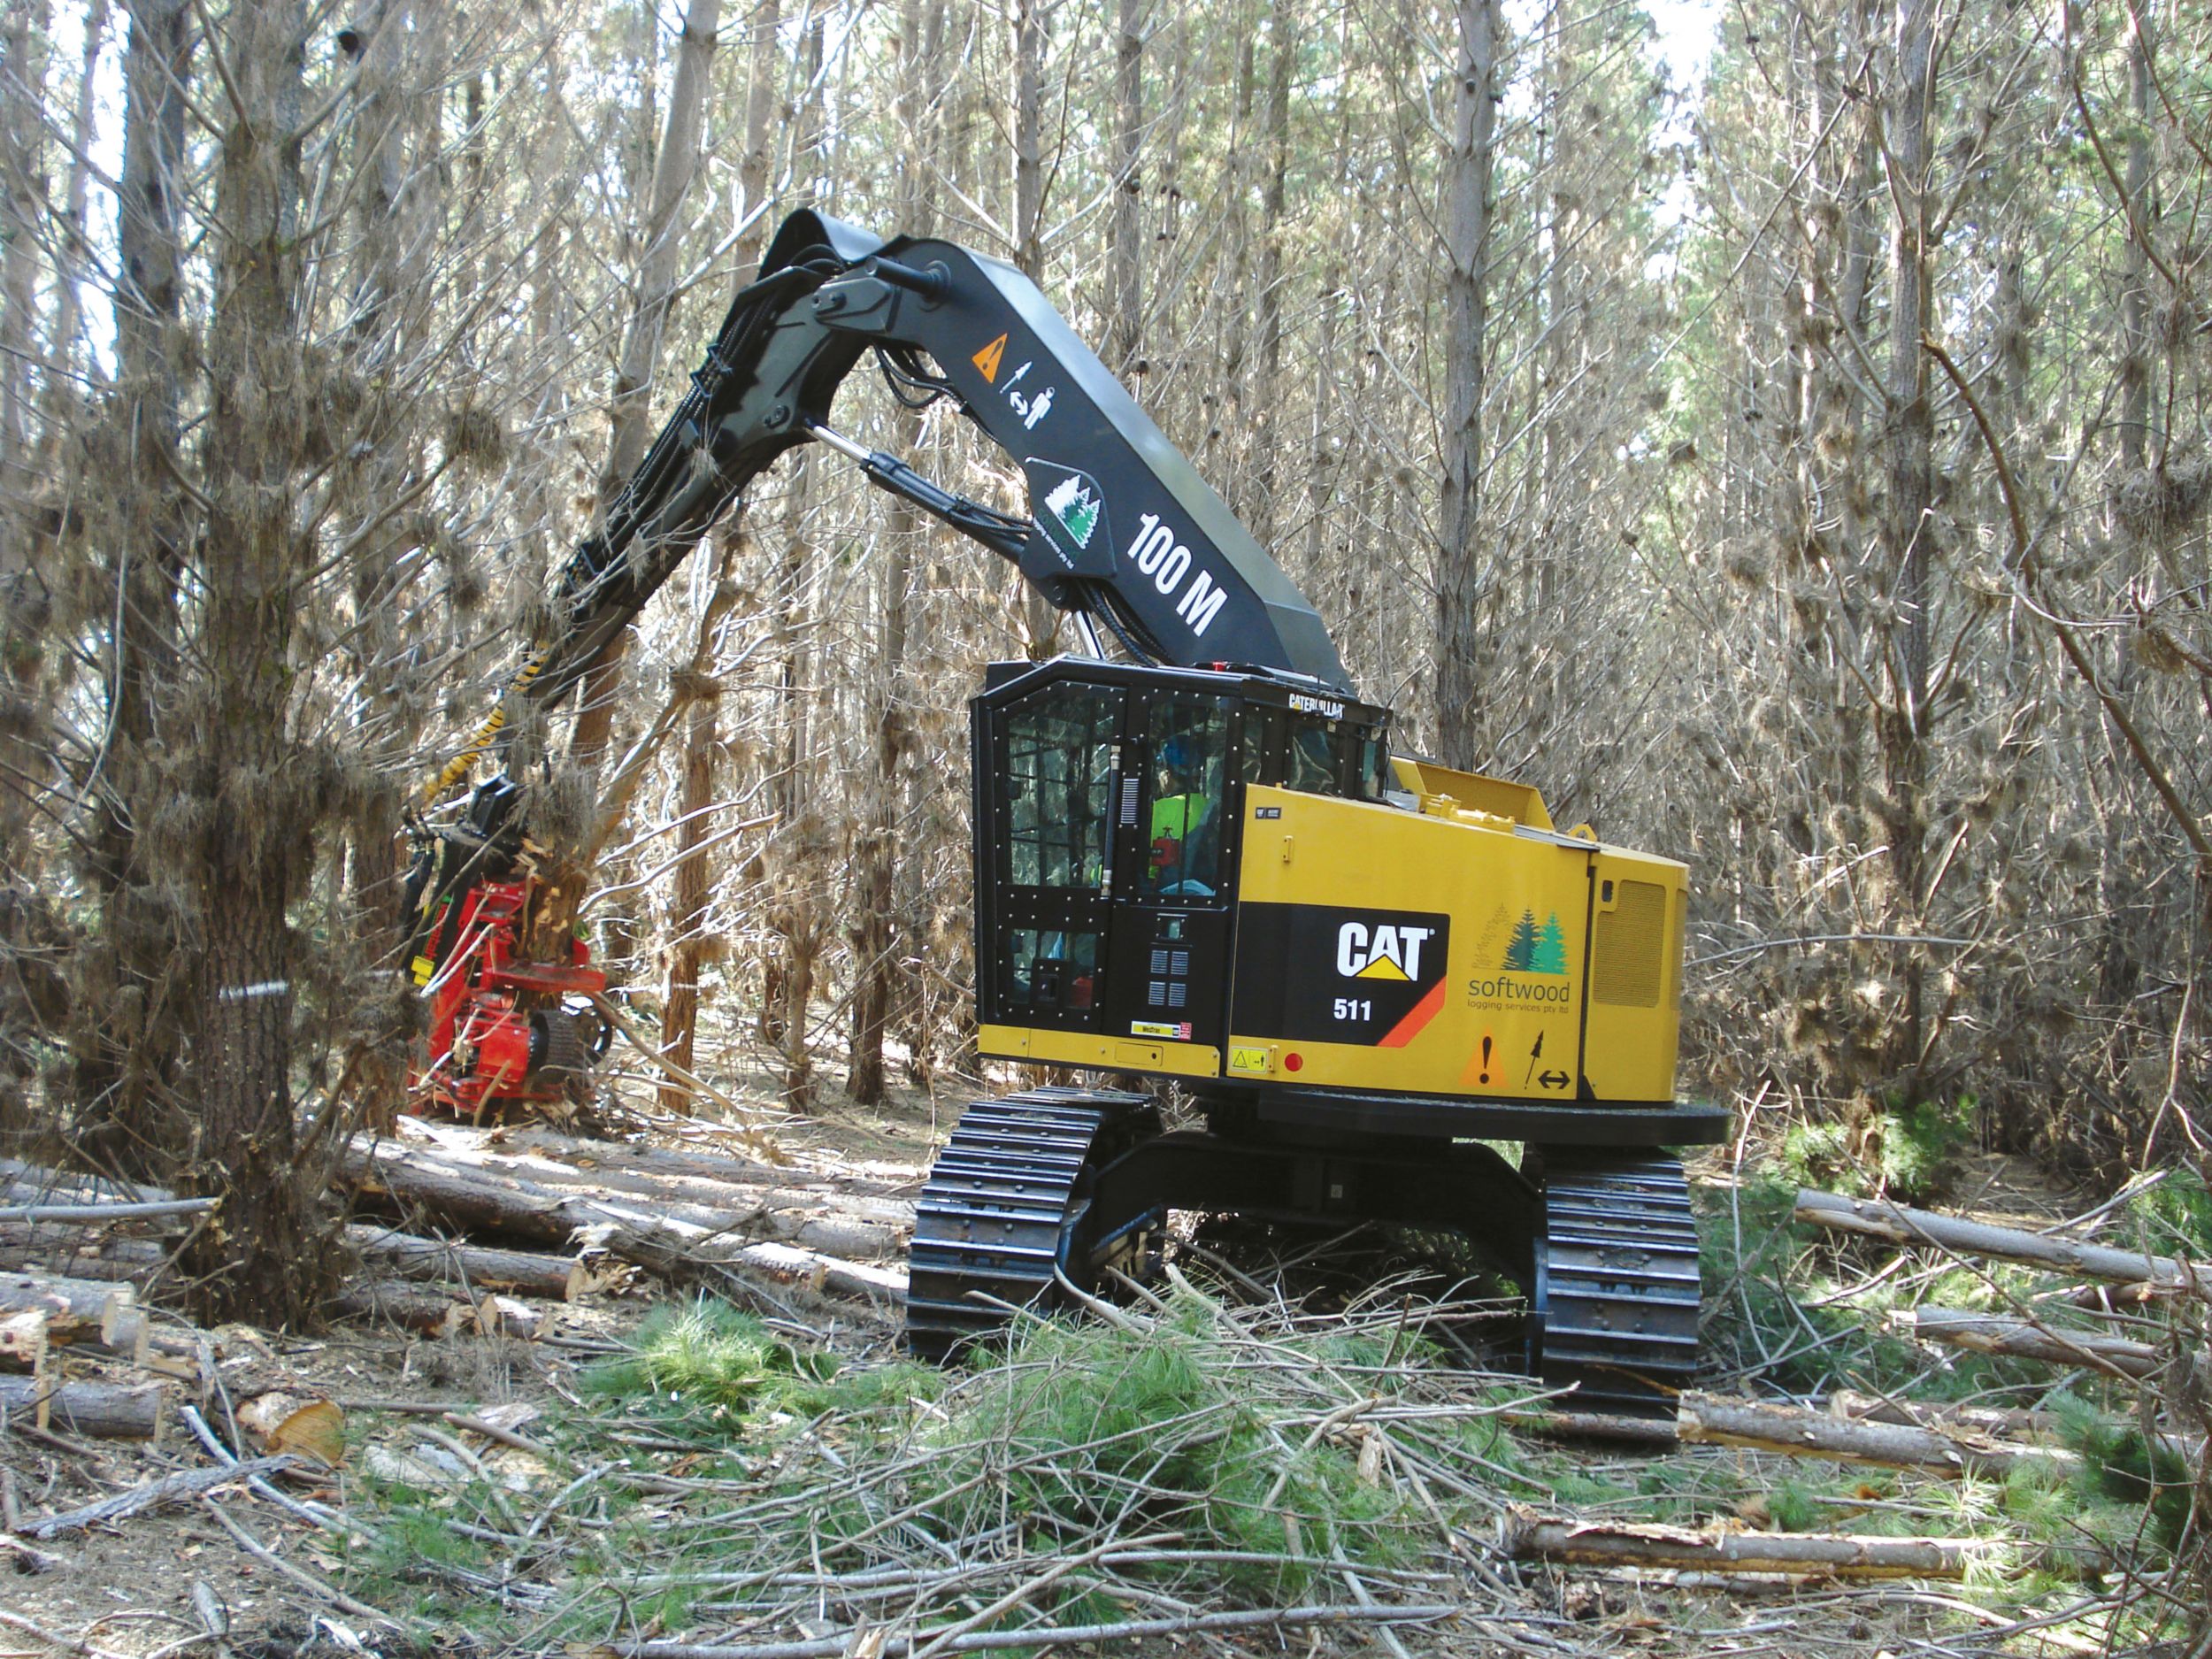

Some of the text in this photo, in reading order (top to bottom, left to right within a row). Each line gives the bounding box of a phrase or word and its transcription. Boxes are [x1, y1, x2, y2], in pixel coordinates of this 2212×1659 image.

[1127, 512, 1228, 637] 100 M
[1337, 922, 1429, 981] CAT
[1468, 976, 1571, 1002] softwood
[1333, 998, 1371, 1021] 511
[1467, 999, 1502, 1011] logging
[1505, 1002, 1540, 1012] services
[1543, 1005, 1555, 1014] pty
